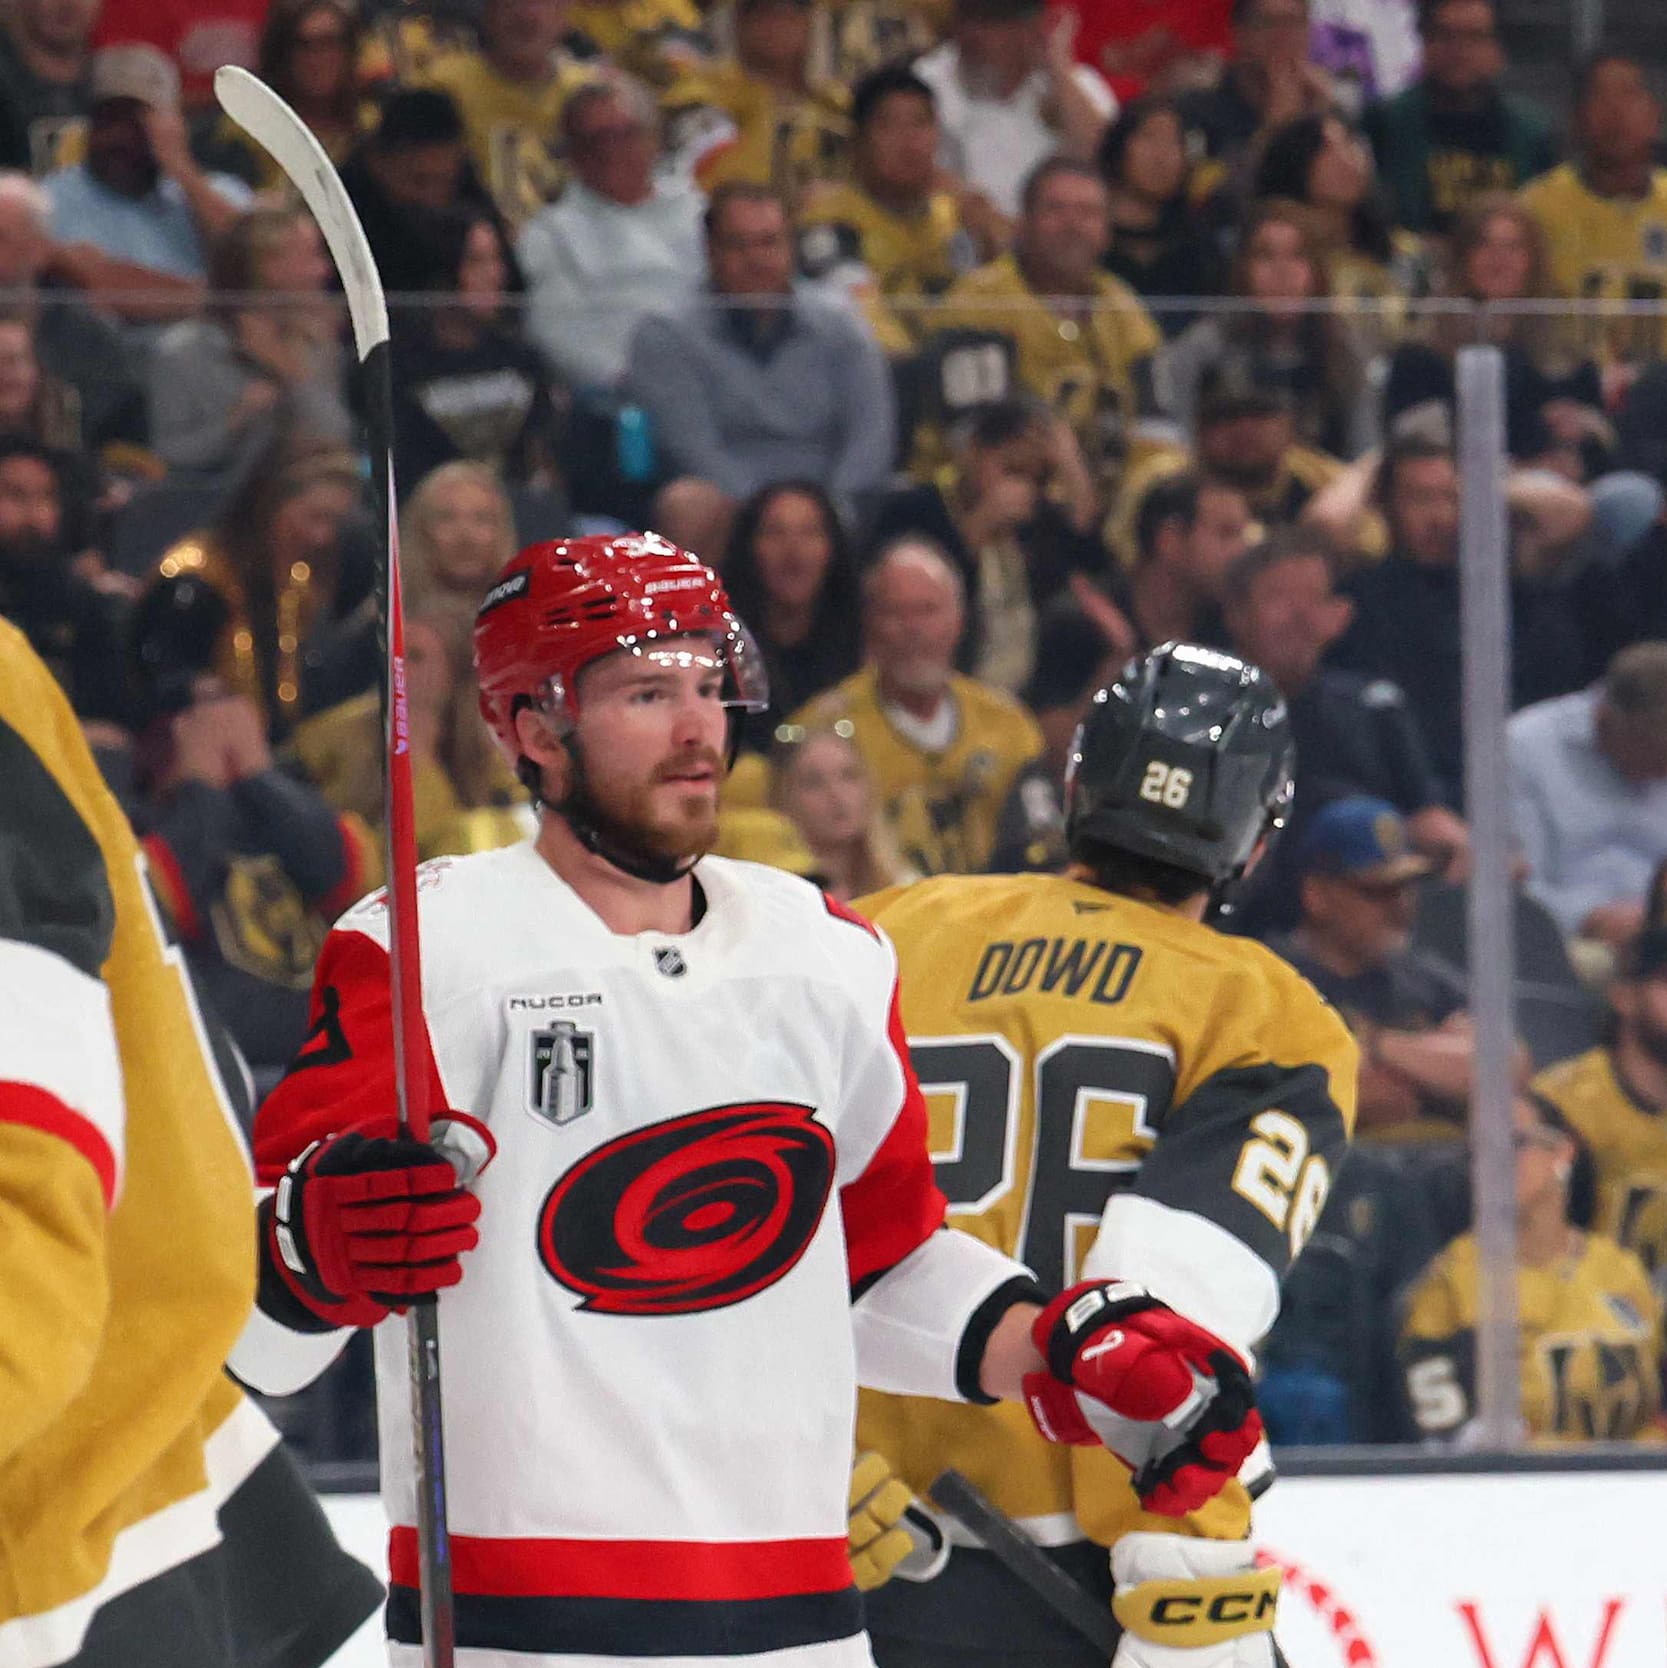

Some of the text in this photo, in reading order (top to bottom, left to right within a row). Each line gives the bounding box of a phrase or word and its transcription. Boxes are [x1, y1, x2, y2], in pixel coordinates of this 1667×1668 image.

[1138, 762, 1192, 809] 26
[509, 993, 603, 1011] NUCOR
[968, 938, 1144, 1006] DOWD
[1211, 1109, 1332, 1264] 26
[1406, 1356, 1469, 1431] 5
